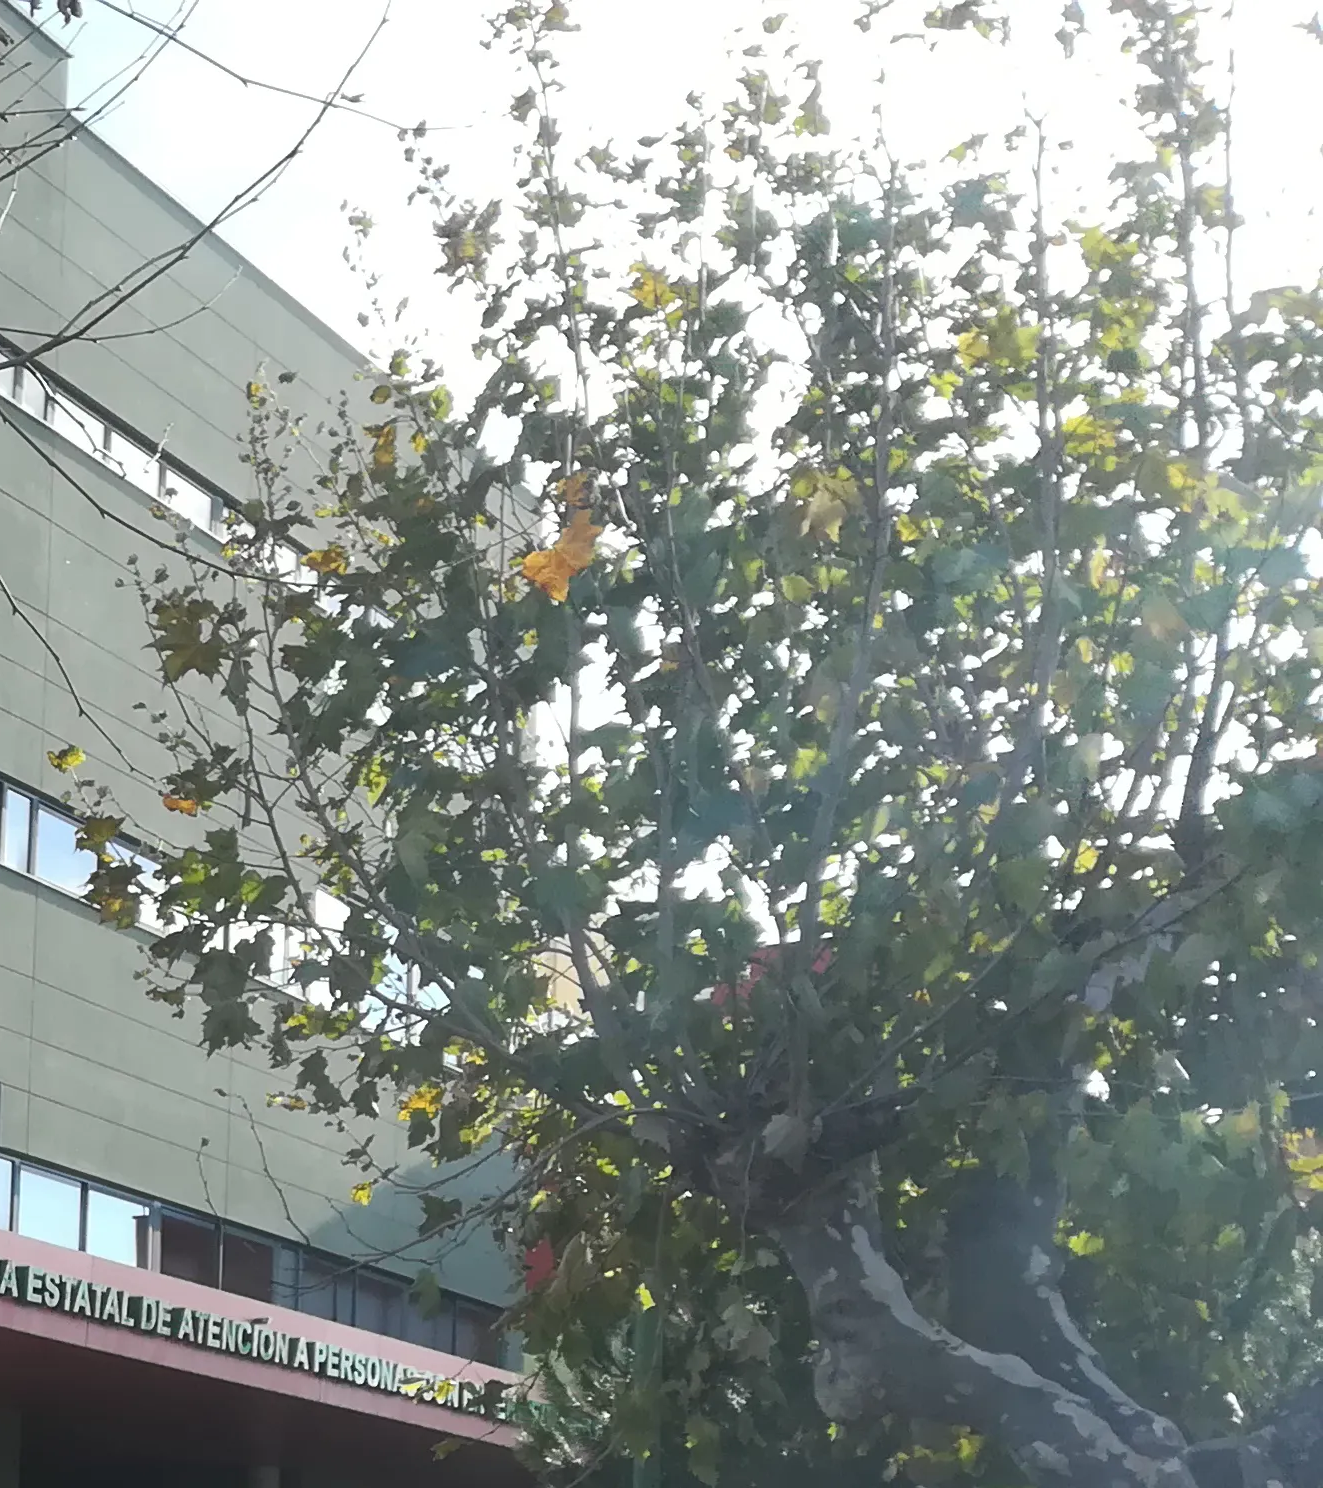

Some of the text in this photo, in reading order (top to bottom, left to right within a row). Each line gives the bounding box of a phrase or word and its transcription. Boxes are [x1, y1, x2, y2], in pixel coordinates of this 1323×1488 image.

[26, 1266, 135, 1327] ESTATAL
[140, 1296, 172, 1337] DE
[293, 1336, 309, 1370] A
